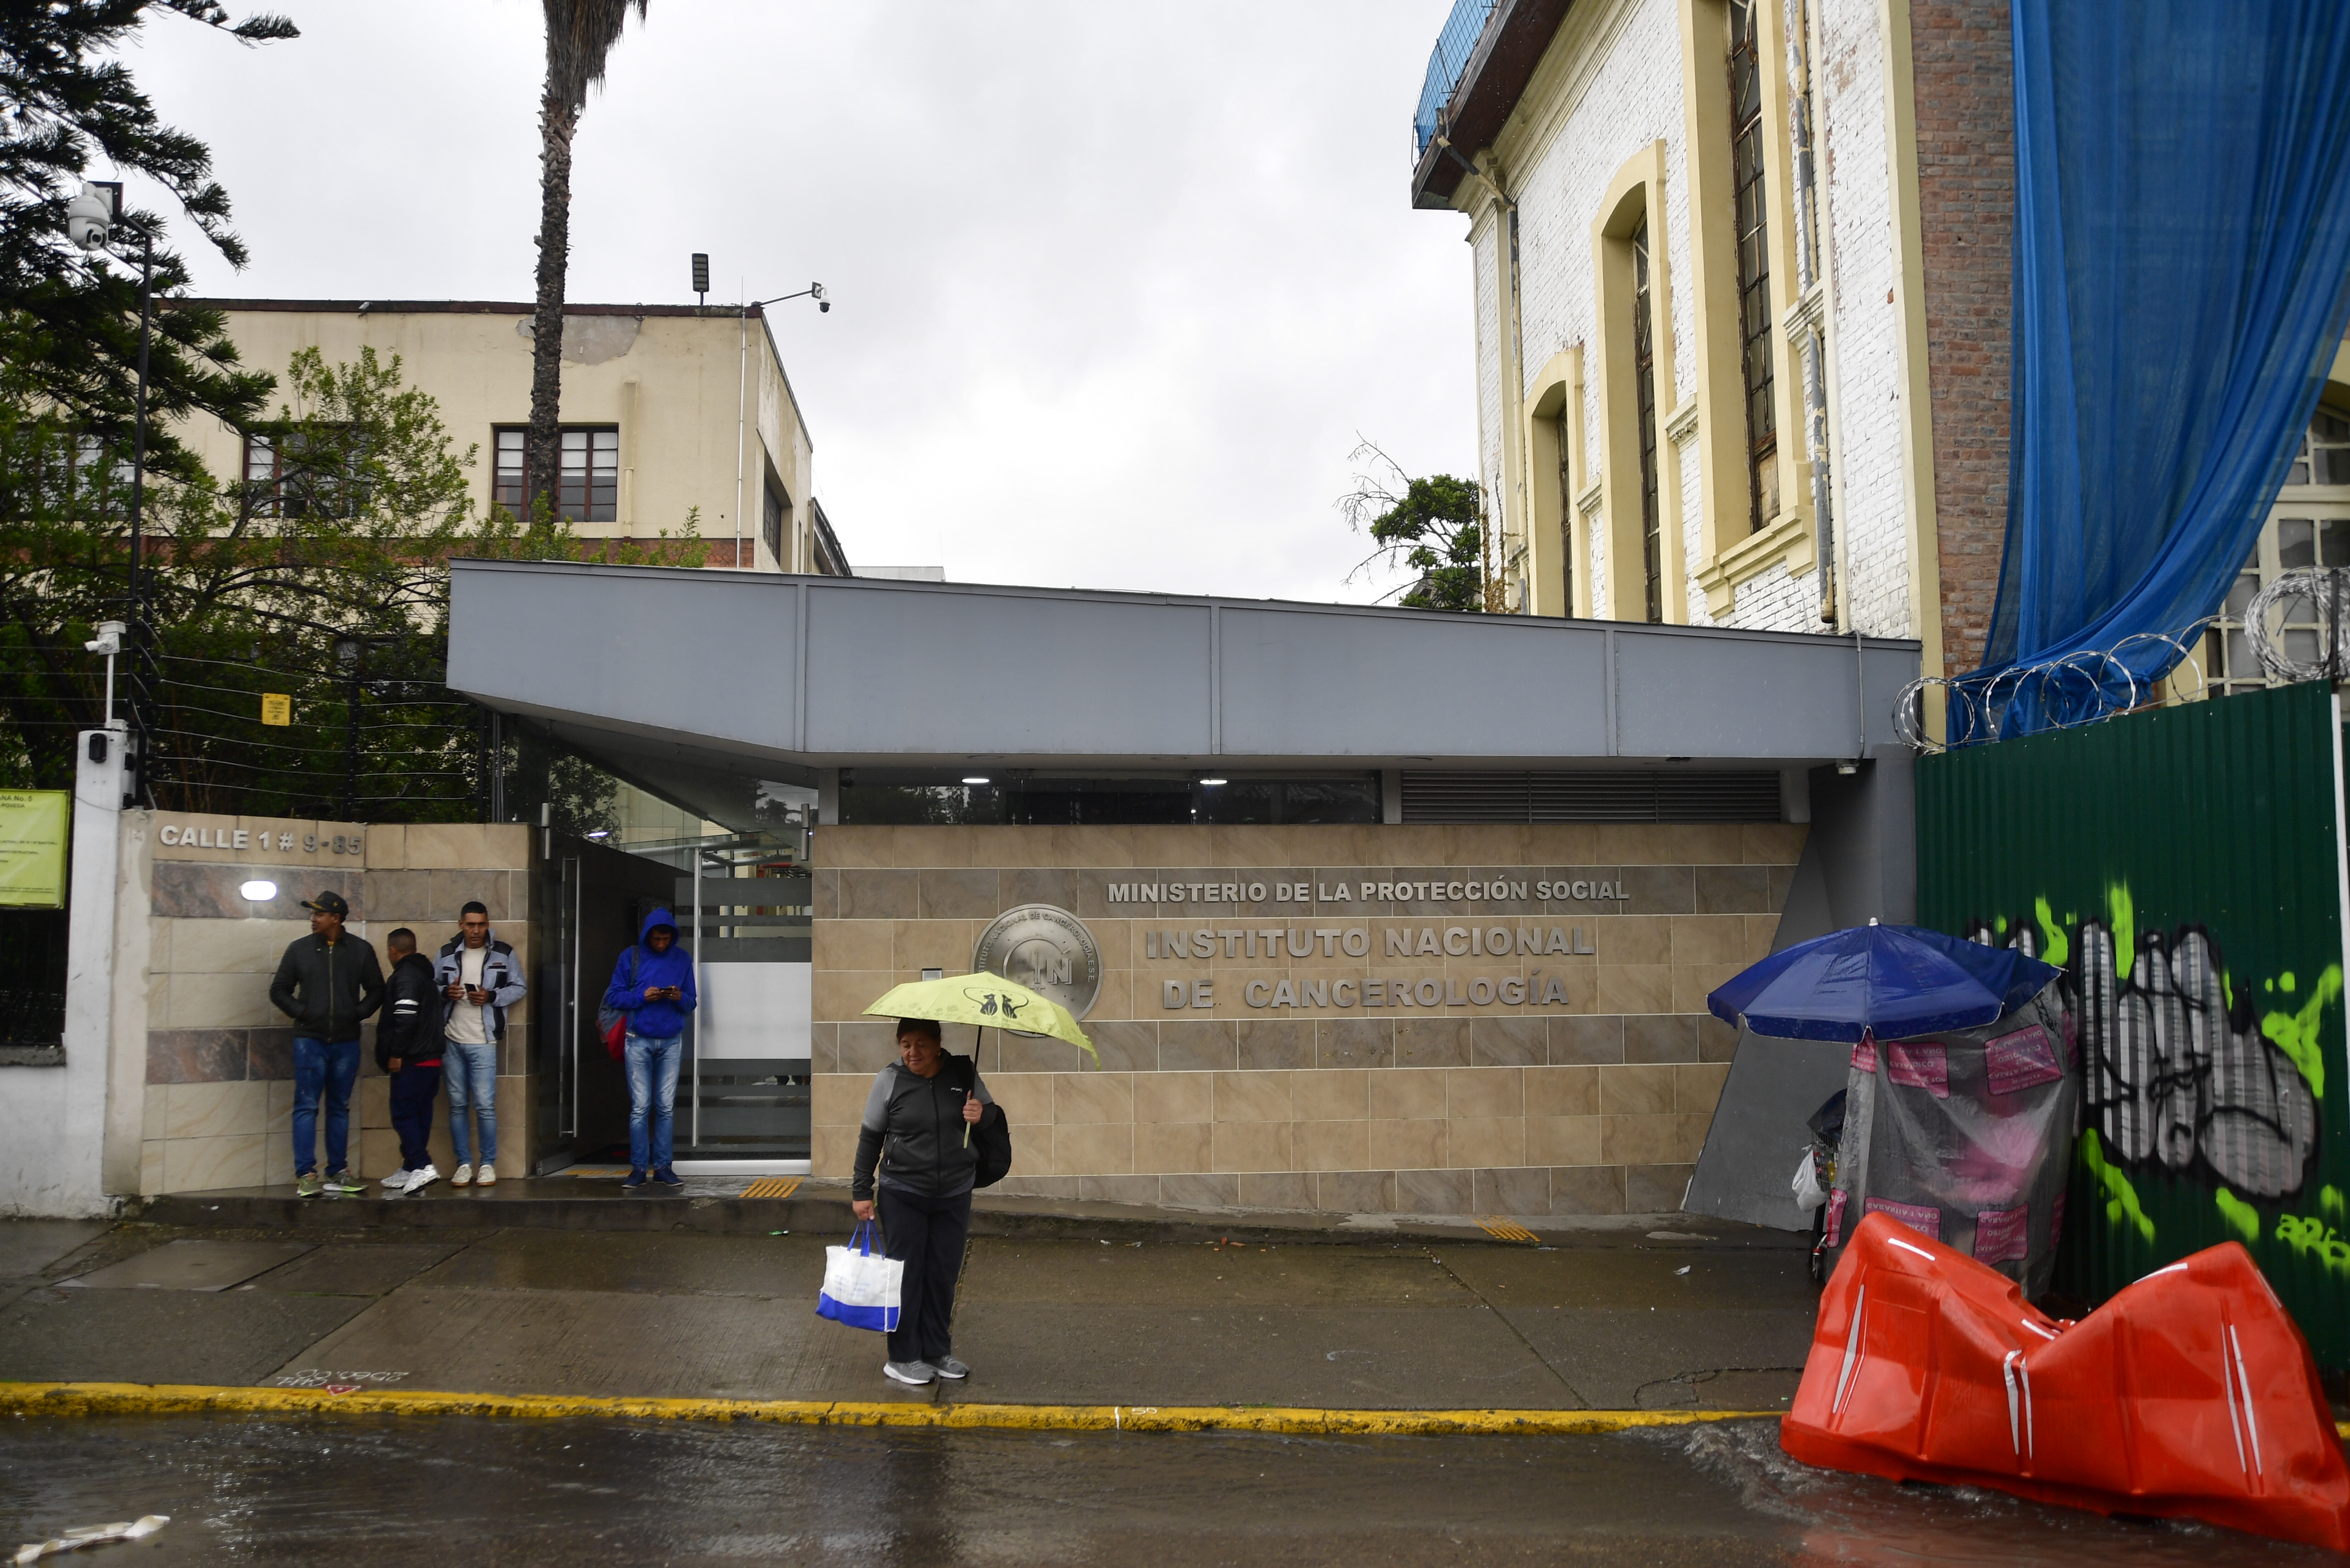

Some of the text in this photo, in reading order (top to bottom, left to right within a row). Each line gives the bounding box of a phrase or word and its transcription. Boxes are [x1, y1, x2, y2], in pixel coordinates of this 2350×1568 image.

[159, 825, 362, 855] CALLE 1 # 9-85
[1108, 874, 1630, 902] MINISTERIO DE LA PROTECCIÓN SOCIAL
[979, 941, 992, 973] STITUTO
[990, 914, 1028, 941] NACIONAL
[1147, 927, 1595, 958] INSTITUTO NACIONAL
[1163, 968, 1569, 1009] DE CANCEROLOGÍA
